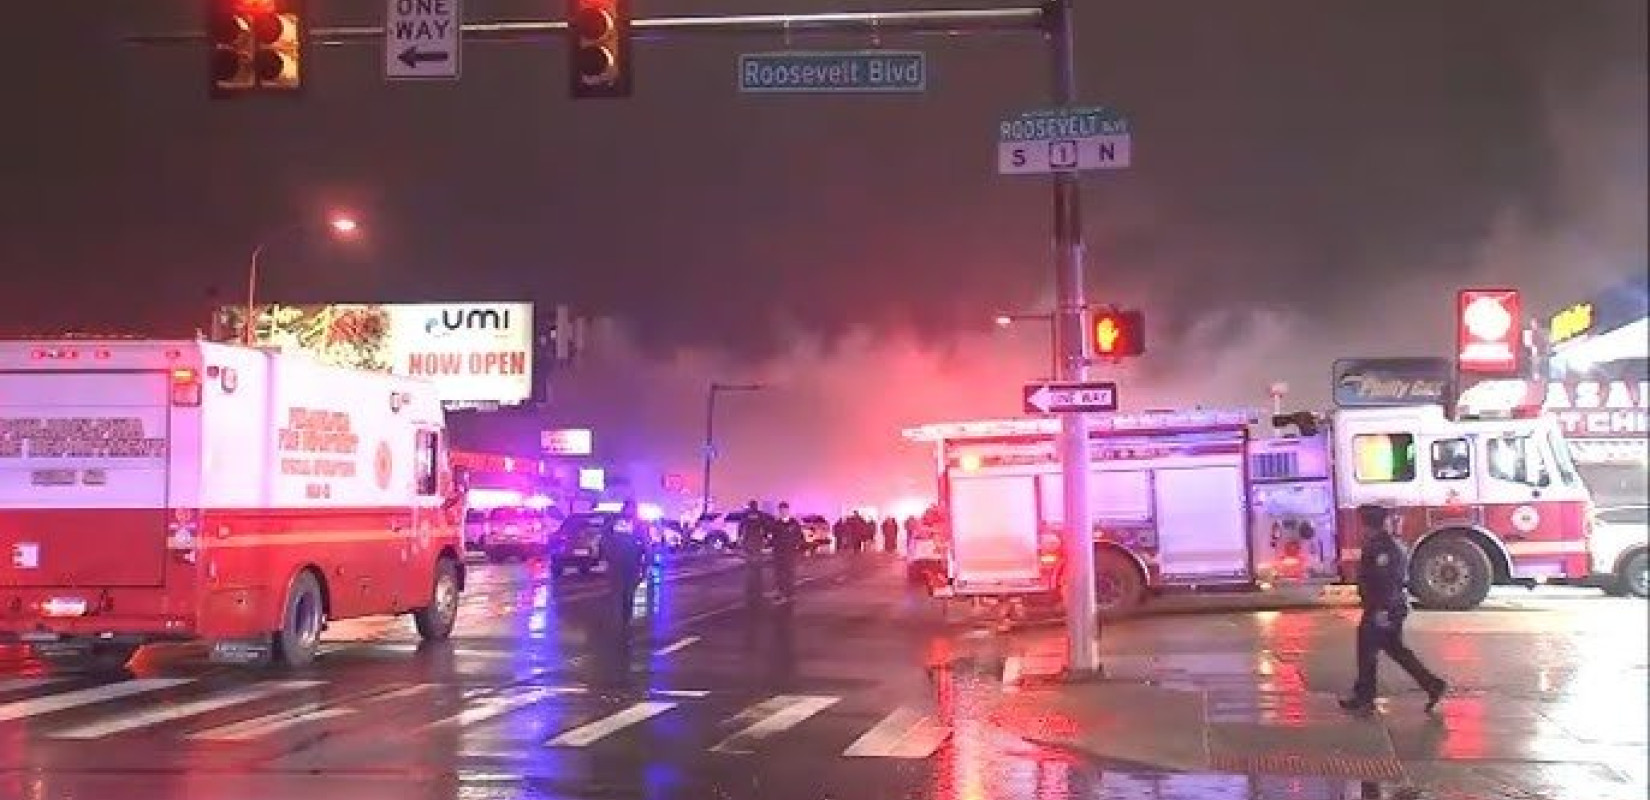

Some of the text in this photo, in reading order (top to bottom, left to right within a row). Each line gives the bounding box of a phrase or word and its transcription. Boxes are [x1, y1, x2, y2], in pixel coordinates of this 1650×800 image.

[396, 0, 449, 15] ONE
[396, 20, 450, 39] WAY
[745, 59, 919, 84] Roosevelt Blvd
[1000, 116, 1096, 140] ROOSEVELT
[1012, 149, 1025, 167] S
[1099, 142, 1114, 162] N
[408, 351, 525, 376] NOW OPEN
[1051, 391, 1107, 404] ONE WAY
